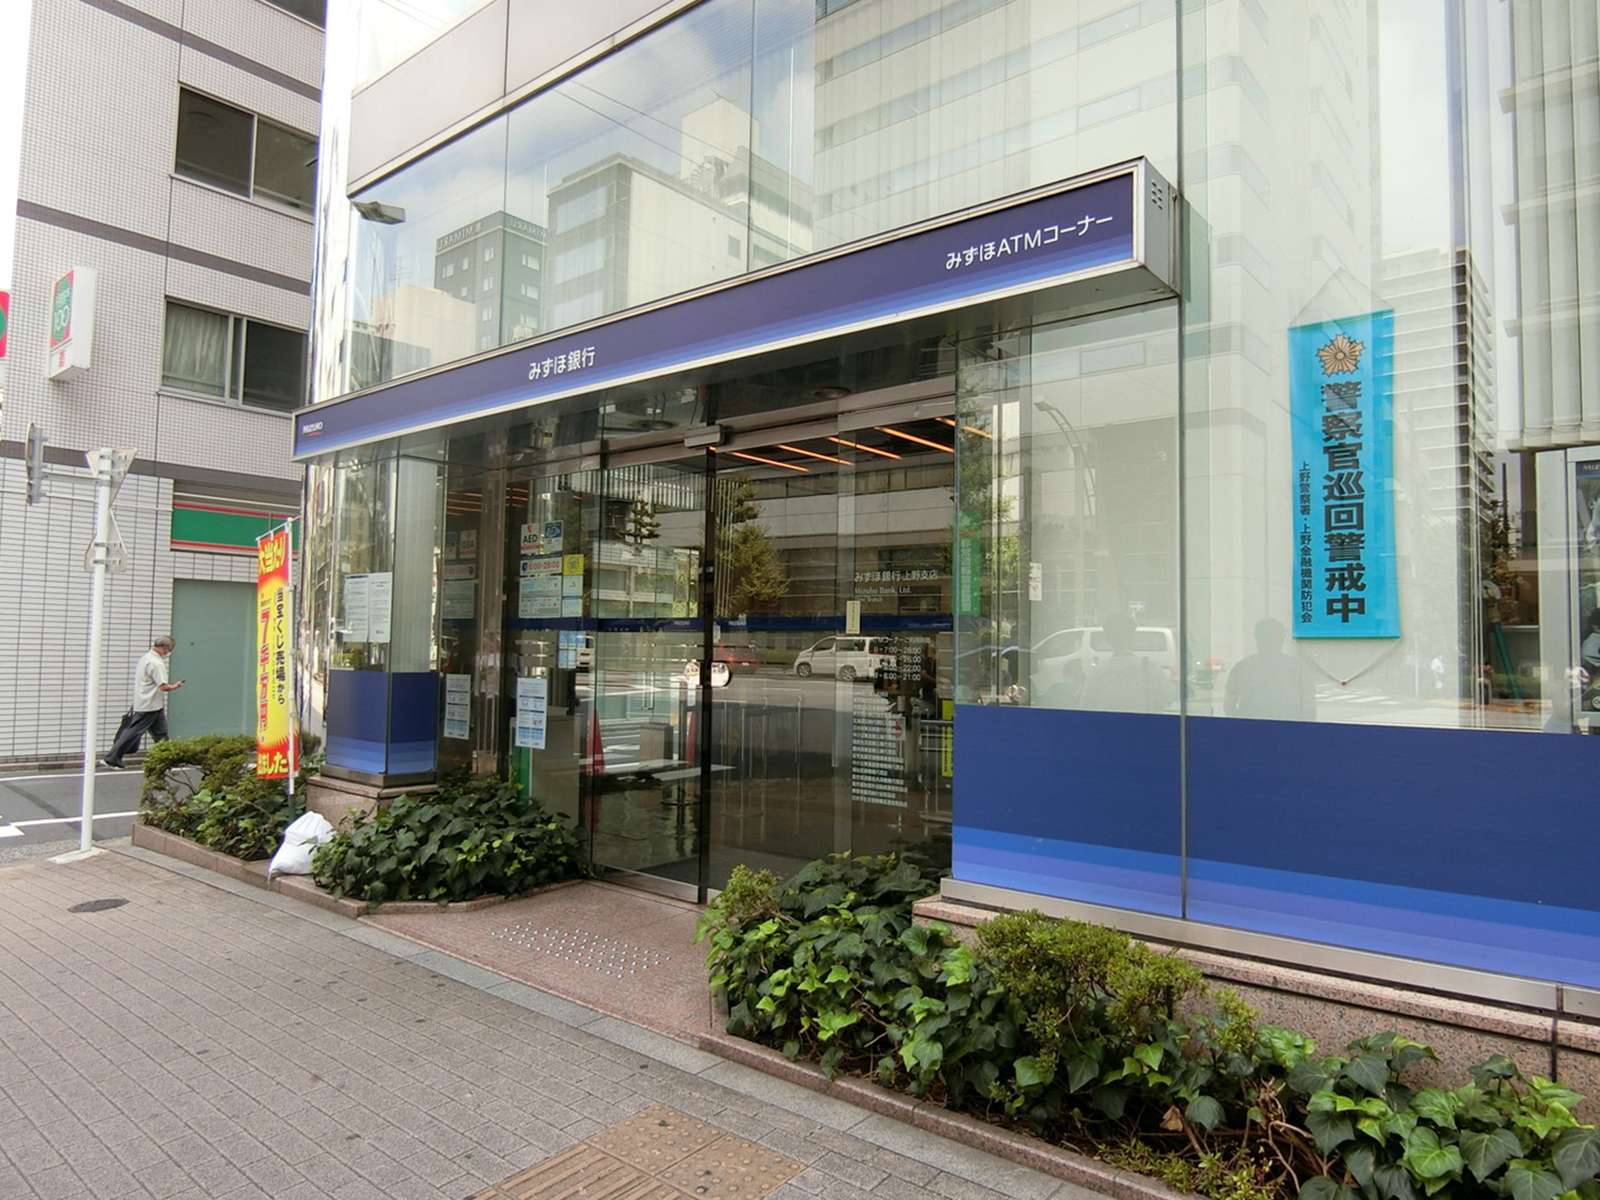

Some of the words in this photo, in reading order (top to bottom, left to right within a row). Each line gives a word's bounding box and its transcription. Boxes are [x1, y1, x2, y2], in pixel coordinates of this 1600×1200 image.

[946, 215, 1113, 270] みずほATMコーナー
[528, 346, 596, 381] みずほ銀行
[1321, 381, 1367, 624] 警察官巡回警戒中
[522, 534, 538, 544] AED
[855, 571, 900, 582] みずほ銀行
[902, 569, 939, 580] 上野支店
